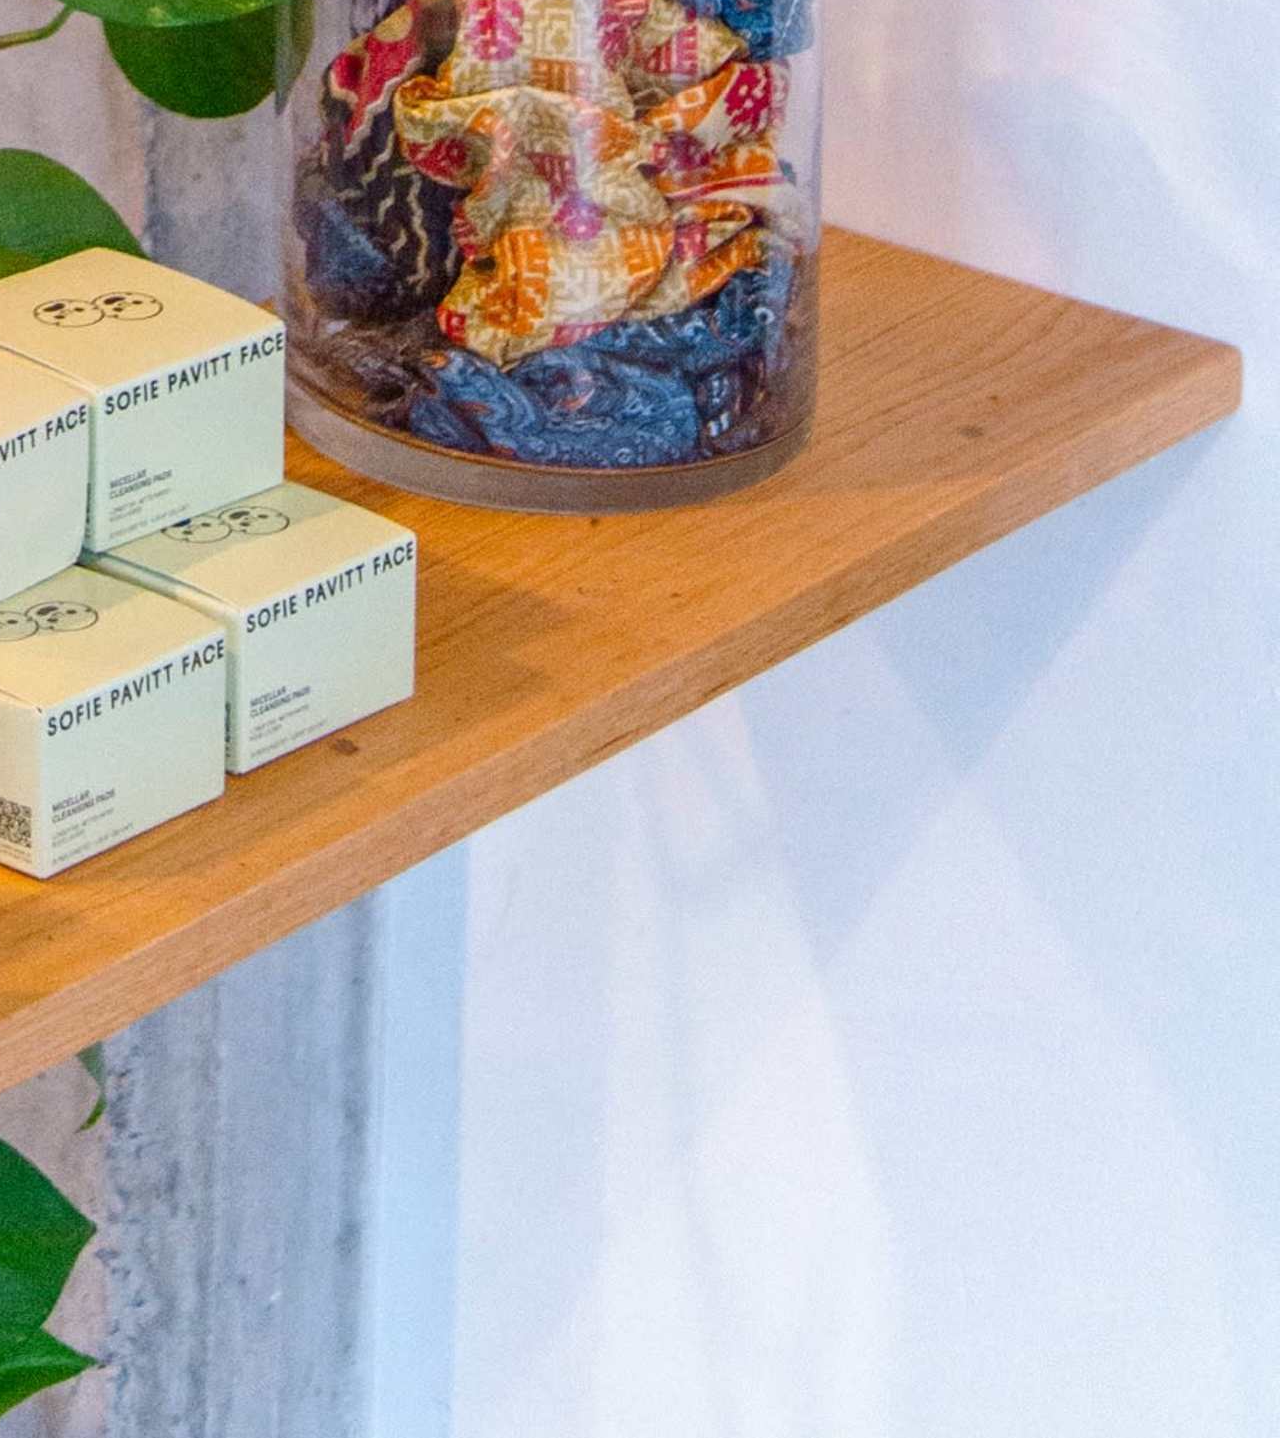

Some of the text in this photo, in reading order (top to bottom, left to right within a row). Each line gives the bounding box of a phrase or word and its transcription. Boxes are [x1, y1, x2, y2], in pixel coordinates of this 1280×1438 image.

[104, 332, 285, 416] SOFIE PAVITT FACE
[45, 404, 88, 441] FACE
[245, 541, 414, 634] SOFIE PAVITT FACE
[46, 638, 225, 738] SOFIE PAVITT FACE
